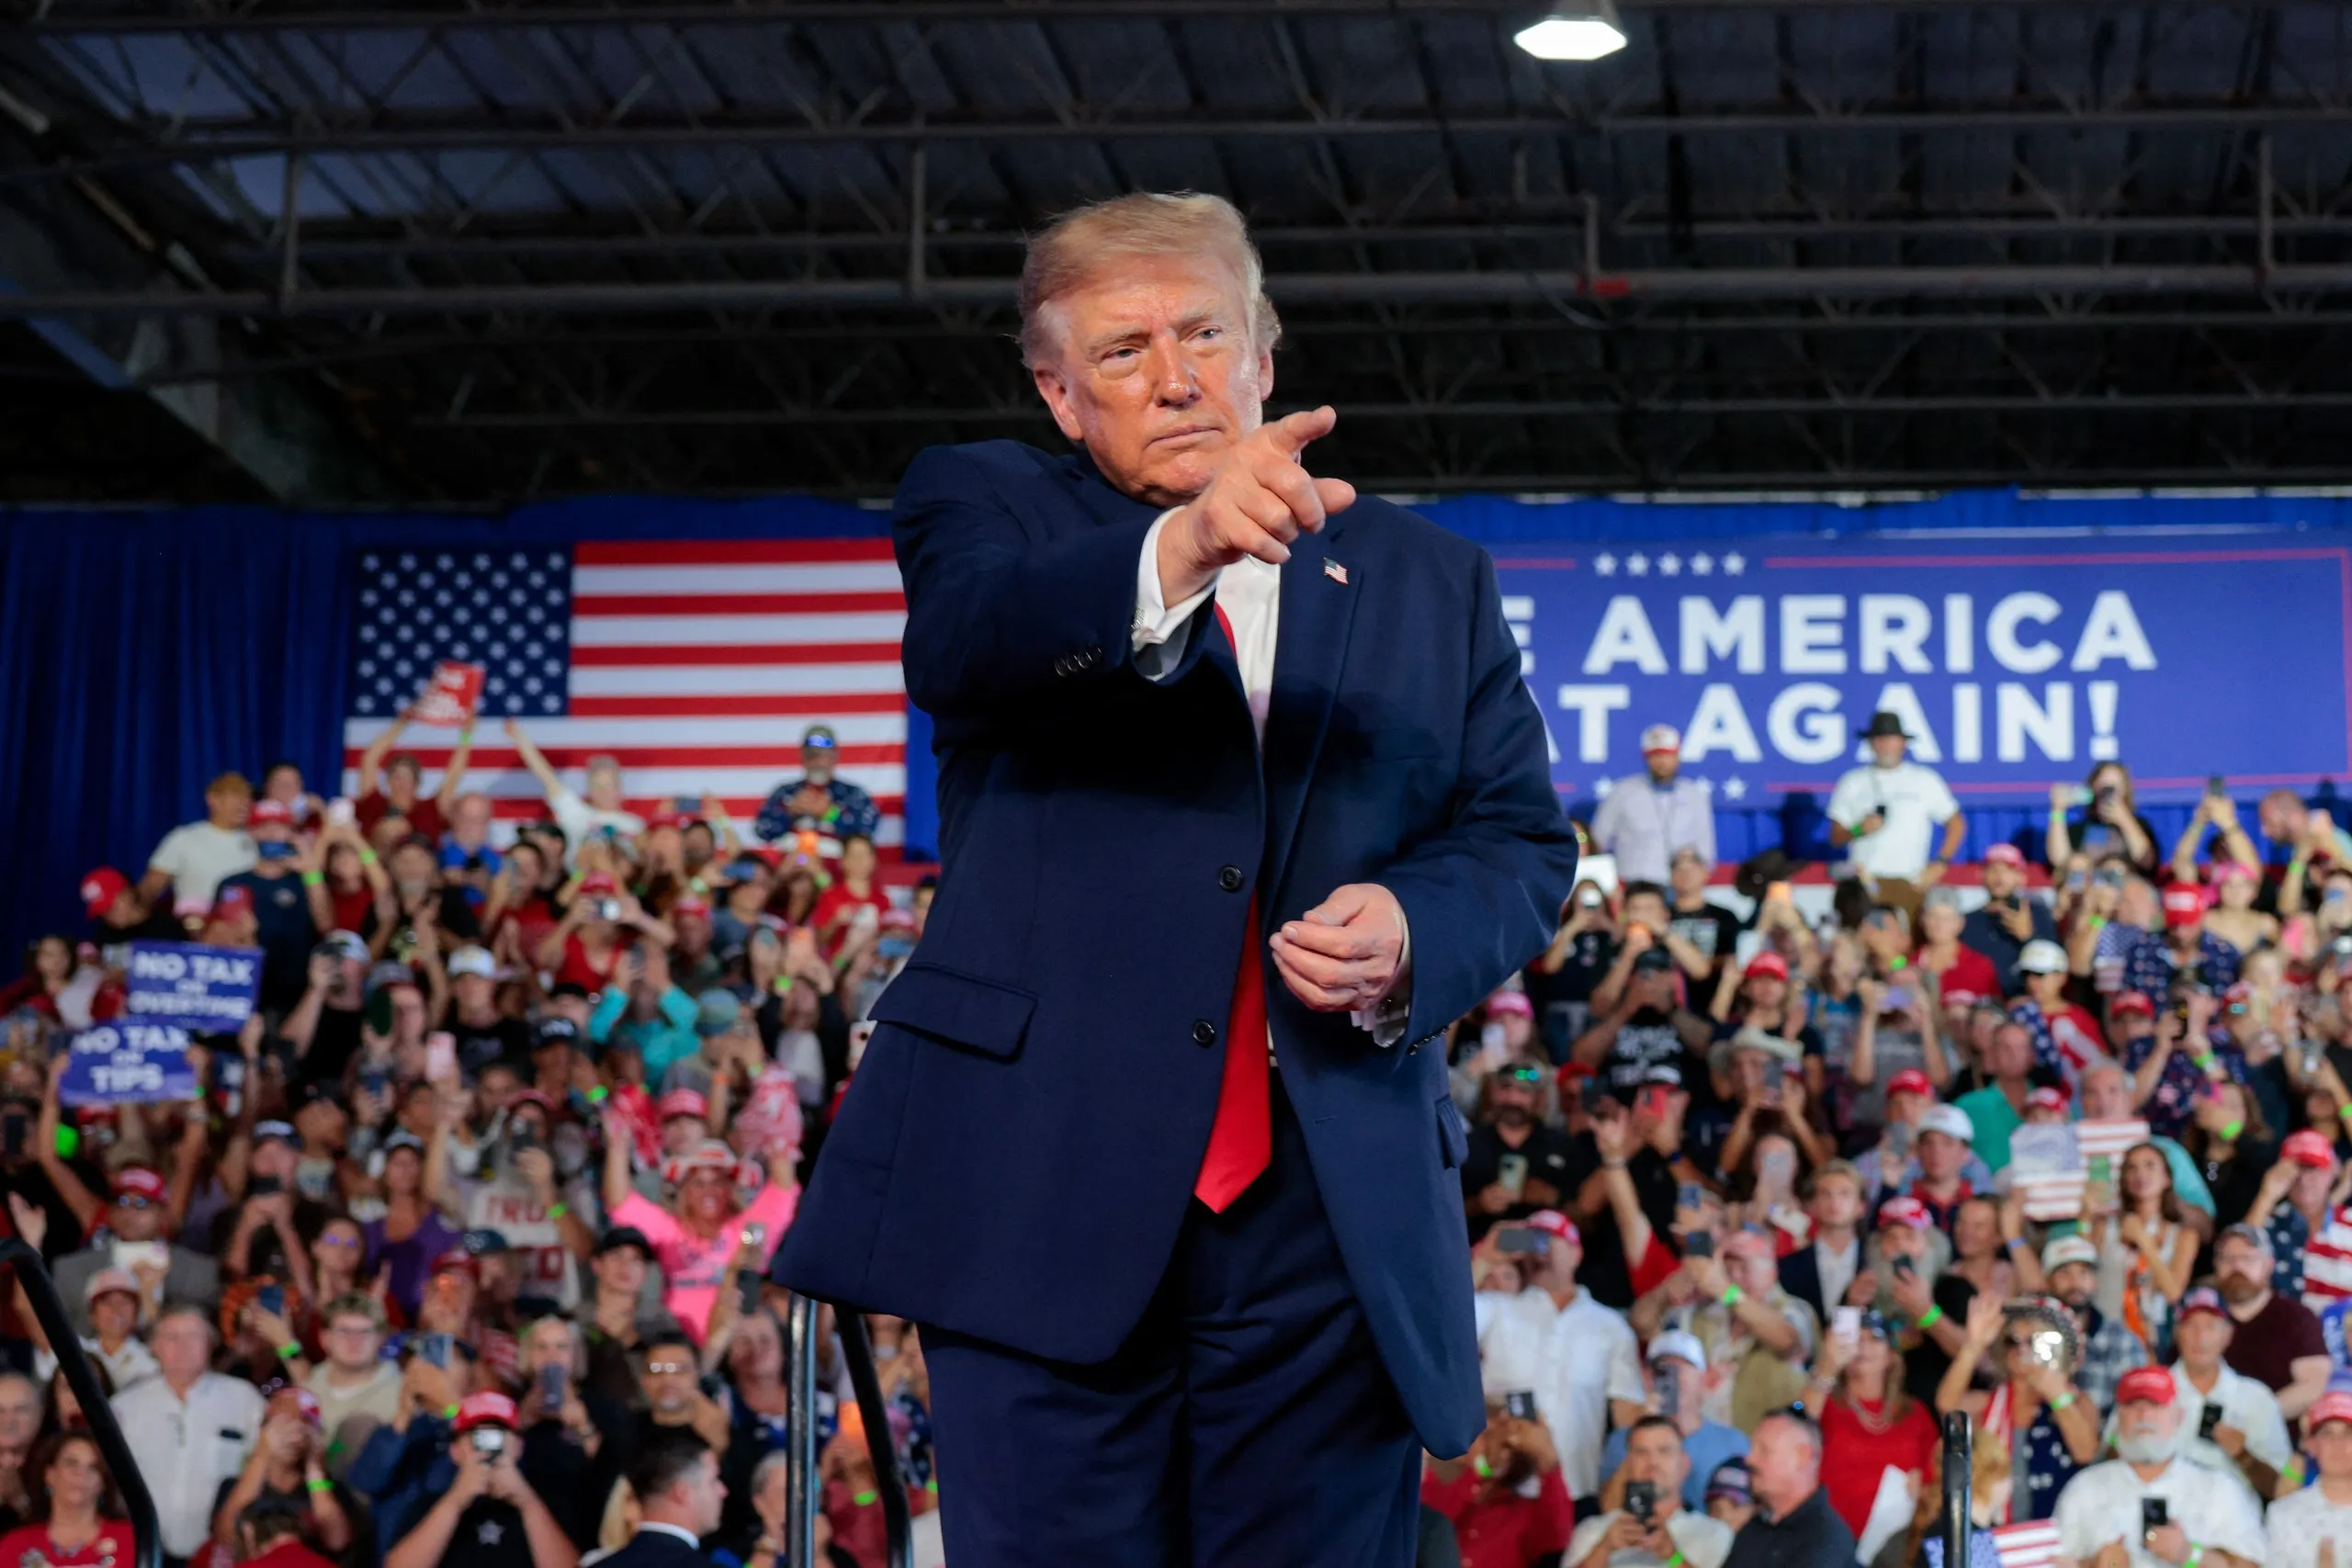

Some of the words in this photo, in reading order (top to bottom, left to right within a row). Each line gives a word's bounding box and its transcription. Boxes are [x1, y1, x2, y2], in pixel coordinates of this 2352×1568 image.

[1582, 590, 2158, 675] AMERICA
[1680, 679, 2120, 764] AGAIN!
[134, 950, 187, 981] NO
[188, 953, 254, 987] TAX
[89, 1062, 165, 1094] TIPS
